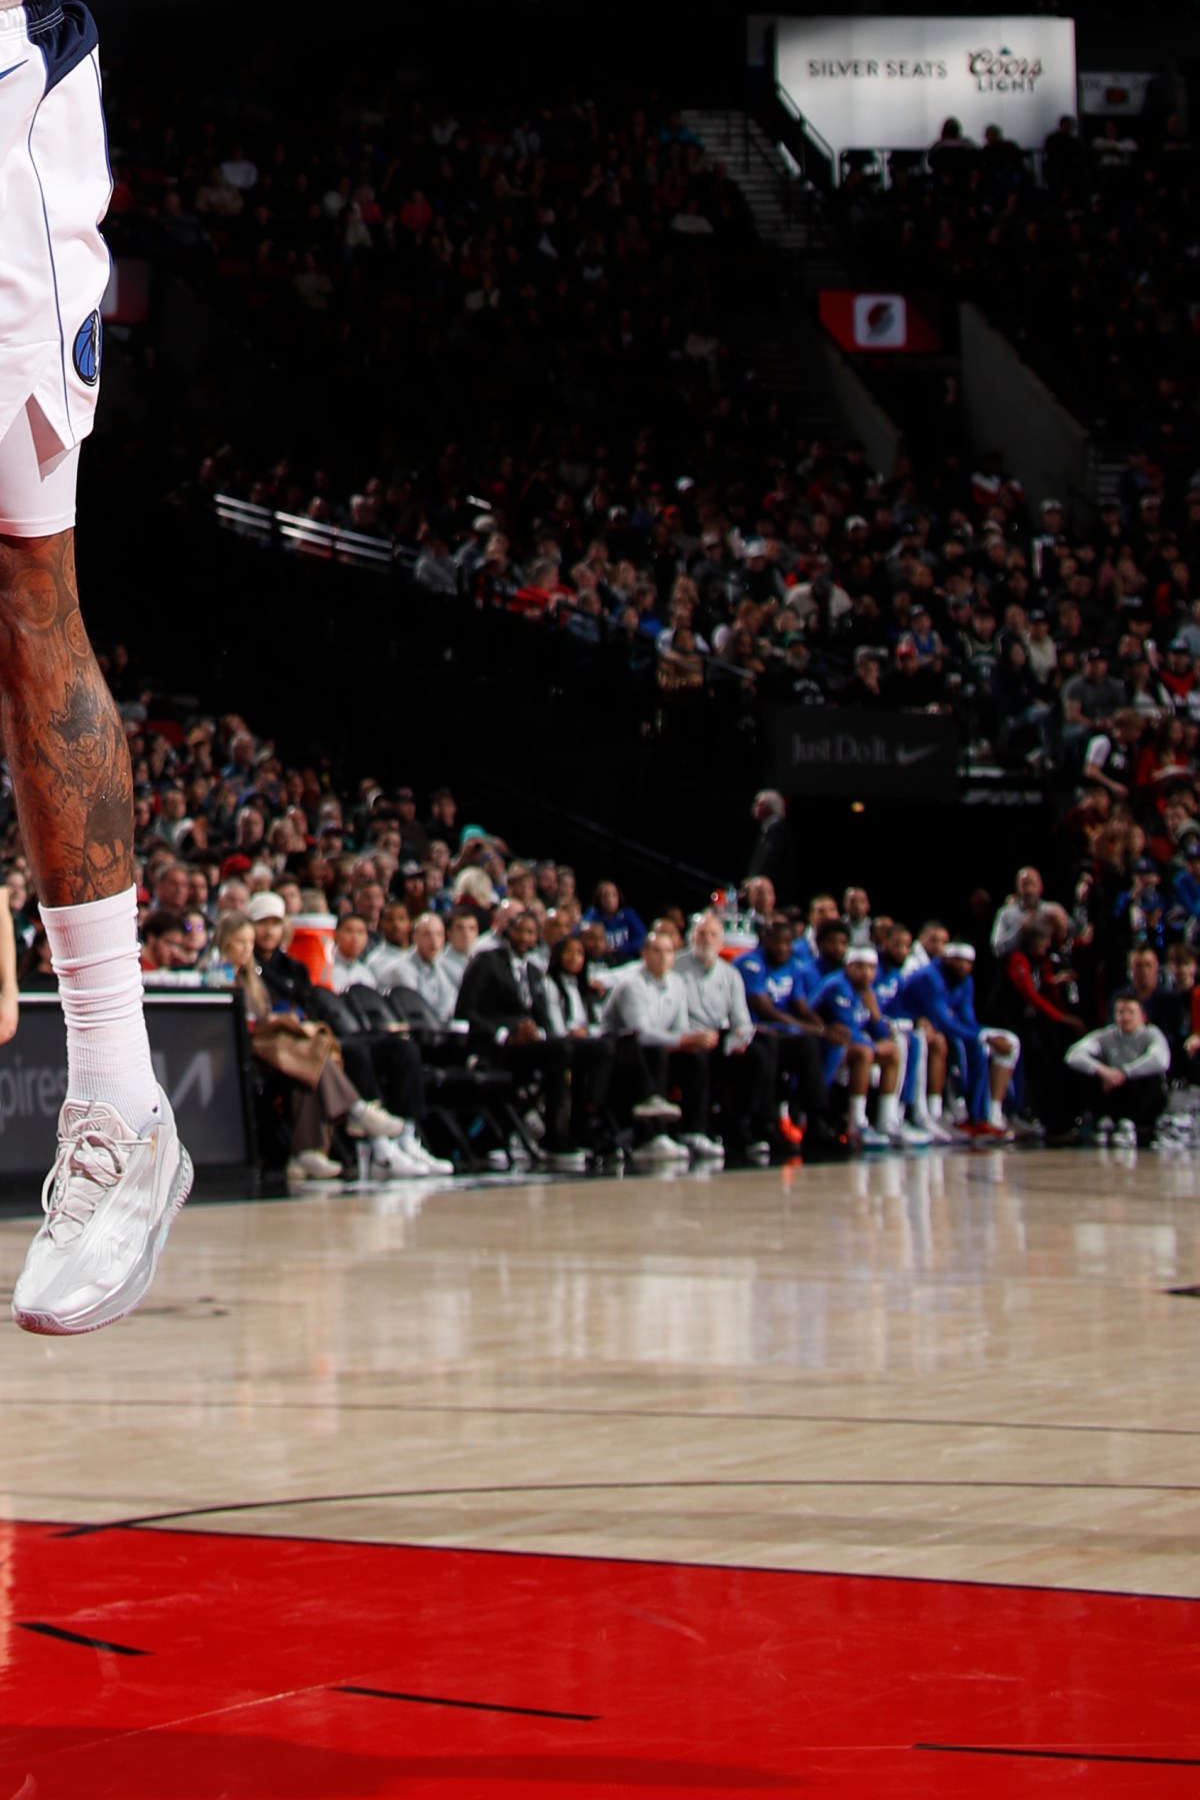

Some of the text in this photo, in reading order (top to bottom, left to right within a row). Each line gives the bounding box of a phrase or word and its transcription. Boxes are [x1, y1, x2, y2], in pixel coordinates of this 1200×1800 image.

[808, 49, 1044, 78] SILVER SEATS Coors
[977, 78, 1036, 93] LIGHT
[791, 733, 831, 766] Just
[835, 733, 871, 764] Do
